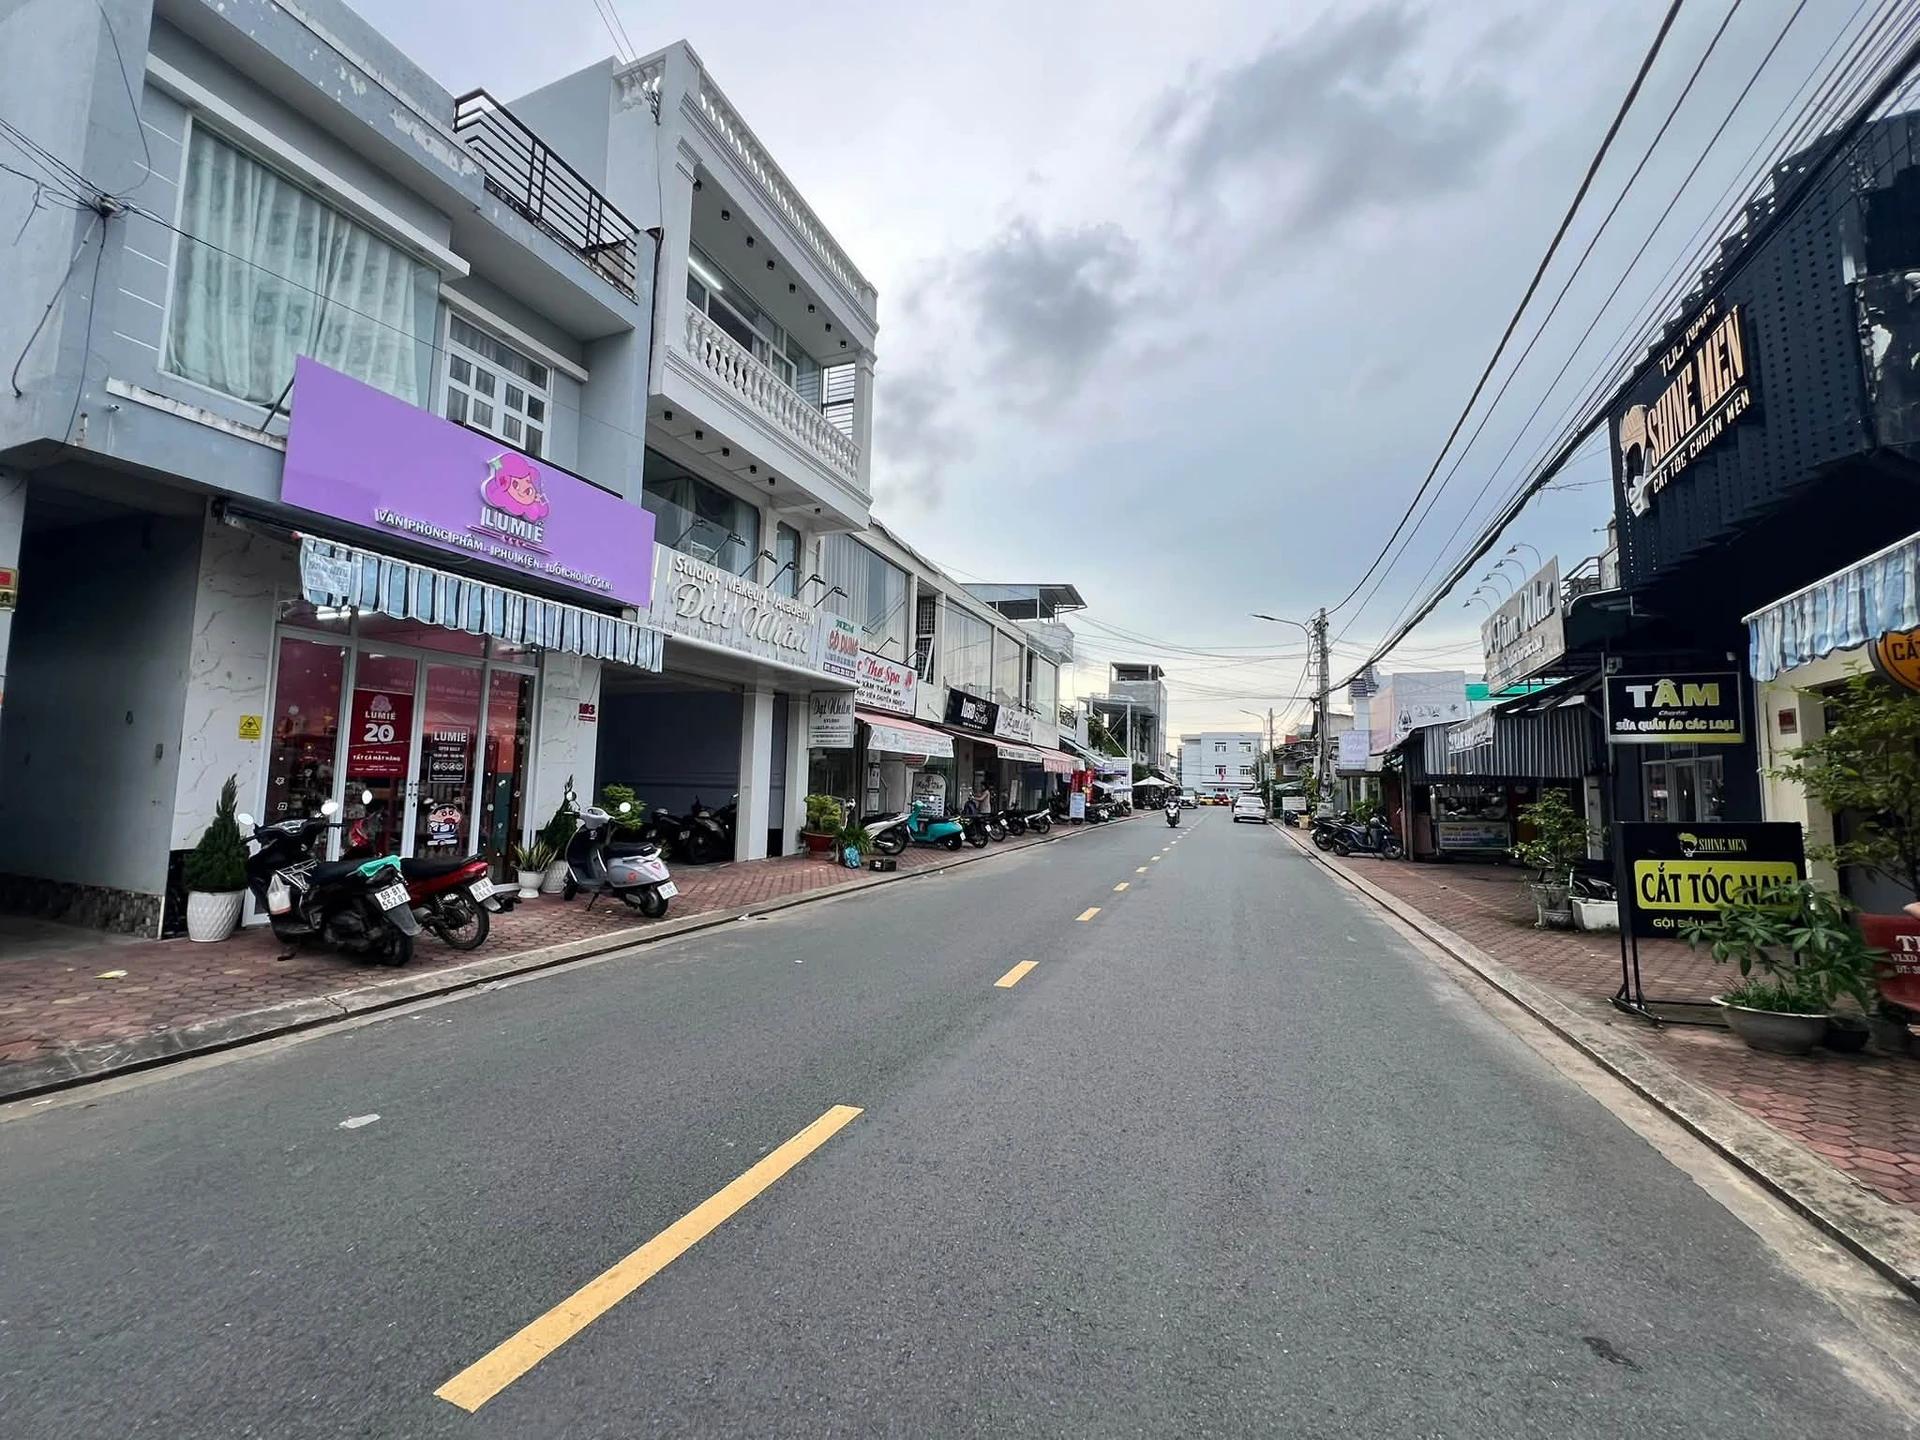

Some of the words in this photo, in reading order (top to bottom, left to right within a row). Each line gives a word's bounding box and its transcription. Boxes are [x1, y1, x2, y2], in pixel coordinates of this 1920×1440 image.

[1647, 361, 1697, 468] SHINE
[1696, 304, 1745, 417] MEN
[1726, 388, 1751, 424] MEN
[675, 556, 715, 583] Studio
[886, 665, 901, 685] Spa
[1625, 679, 1720, 708] TÂM
[1668, 718, 1684, 730] ÁO
[1685, 718, 1707, 730] CÁC
[1699, 838, 1726, 851] SHINE
[1727, 838, 1747, 851] MEN
[1641, 862, 1682, 903] CẮT
[1688, 867, 1735, 904] TÓC
[1653, 917, 1675, 929] GỘI
